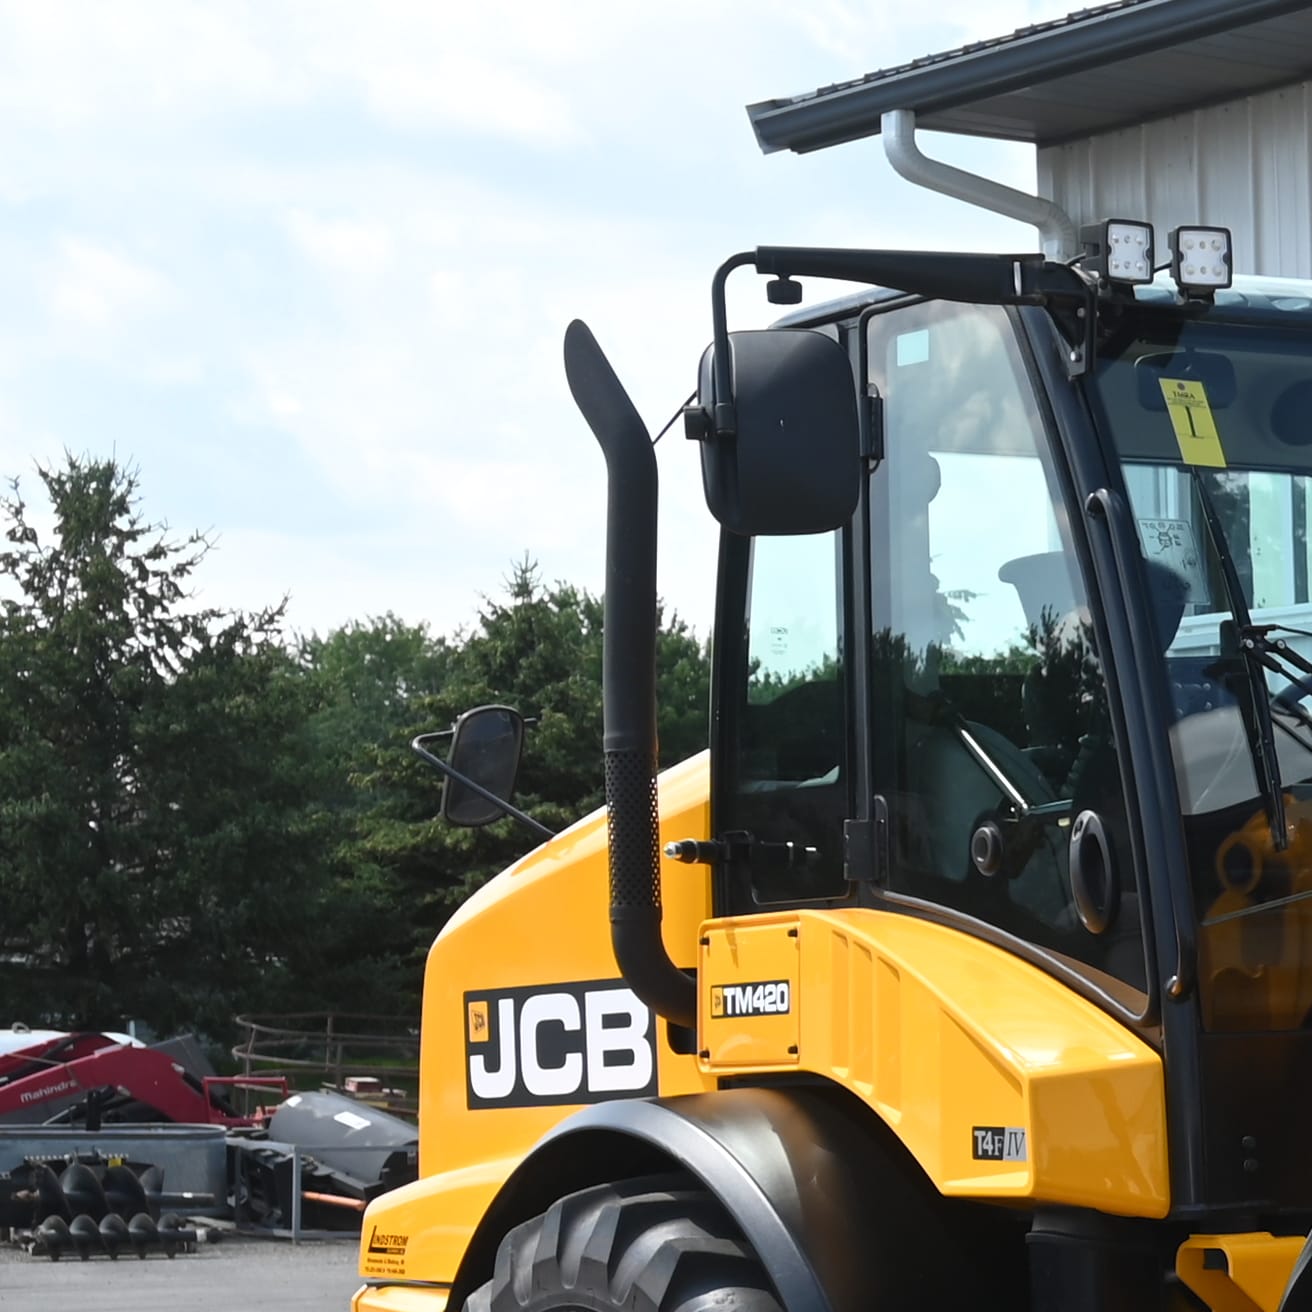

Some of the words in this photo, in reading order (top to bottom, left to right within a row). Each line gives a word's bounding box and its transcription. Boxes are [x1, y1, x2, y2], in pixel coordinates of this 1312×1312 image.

[723, 983, 789, 1015] TM420
[469, 988, 653, 1099] JCB
[974, 1130, 1004, 1156] T4F
